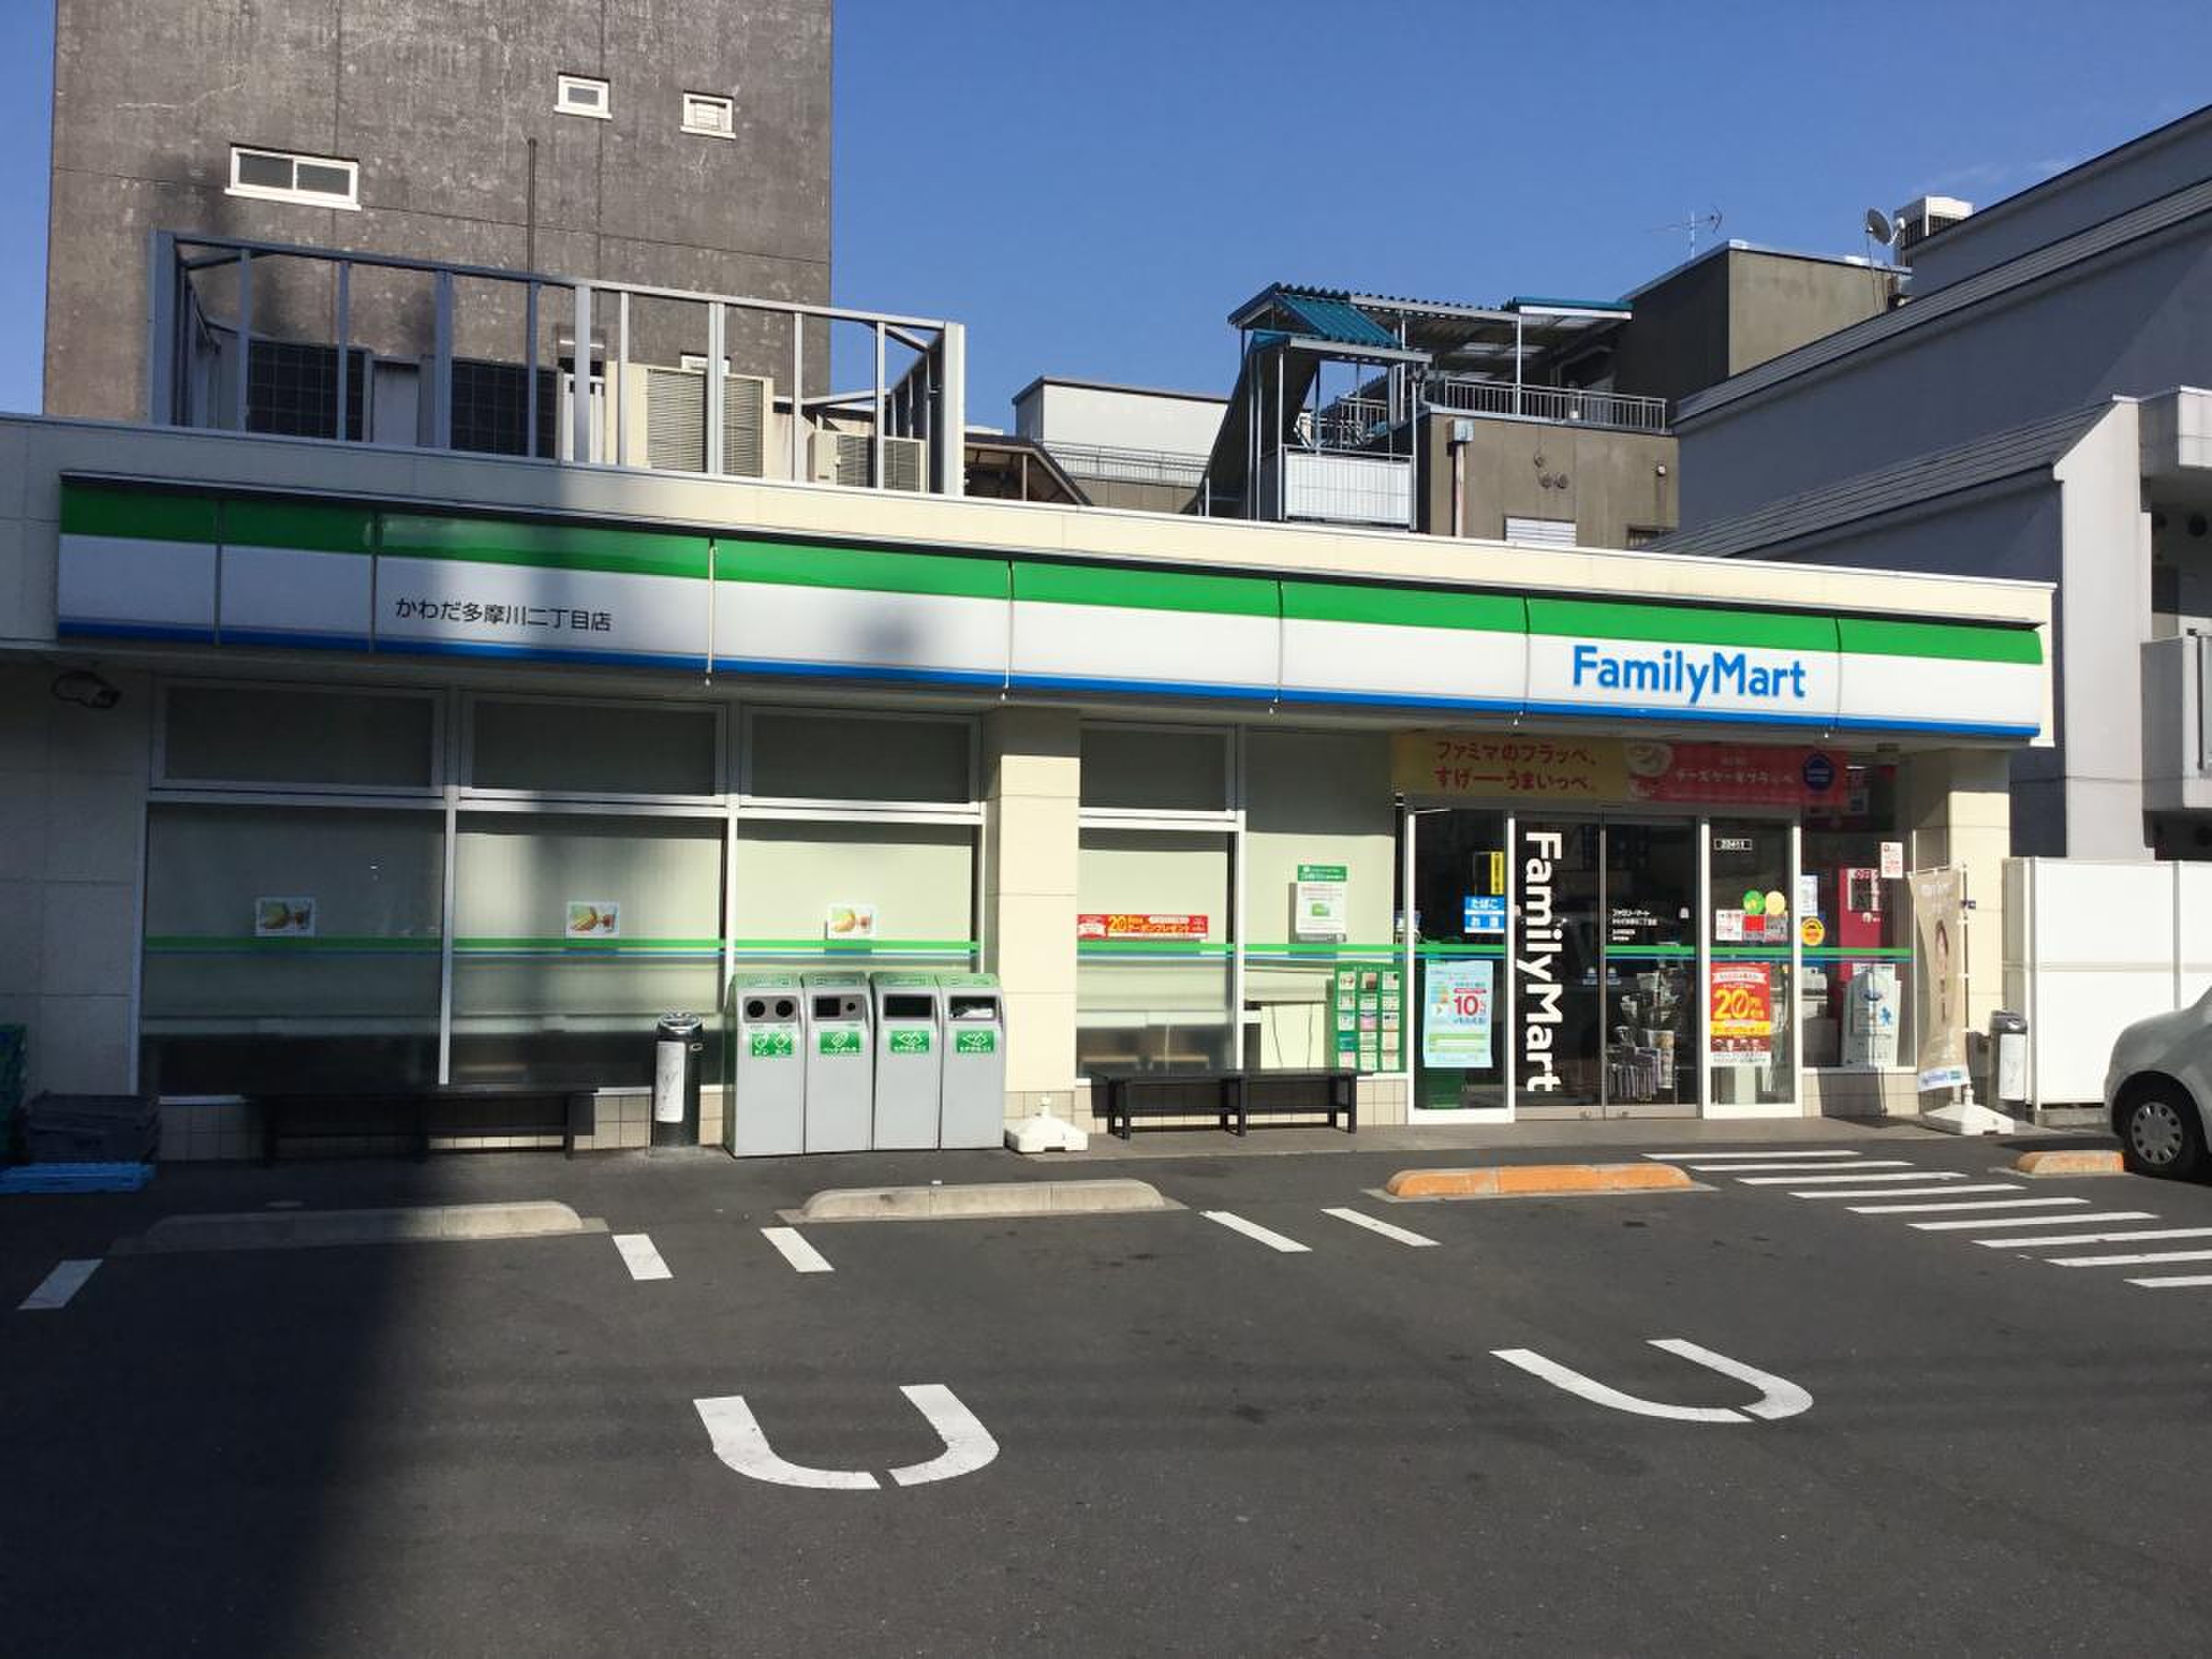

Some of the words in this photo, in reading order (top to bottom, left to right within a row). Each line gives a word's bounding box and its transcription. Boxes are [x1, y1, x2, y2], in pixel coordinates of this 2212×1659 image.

[395, 598, 613, 631] かわだ多摩川二丁目店
[1573, 645, 1806, 704] FamilyMart
[1516, 832, 1562, 1092] FamilyMart
[1453, 995, 1479, 1017] 10
[1714, 988, 1749, 1019] 20
